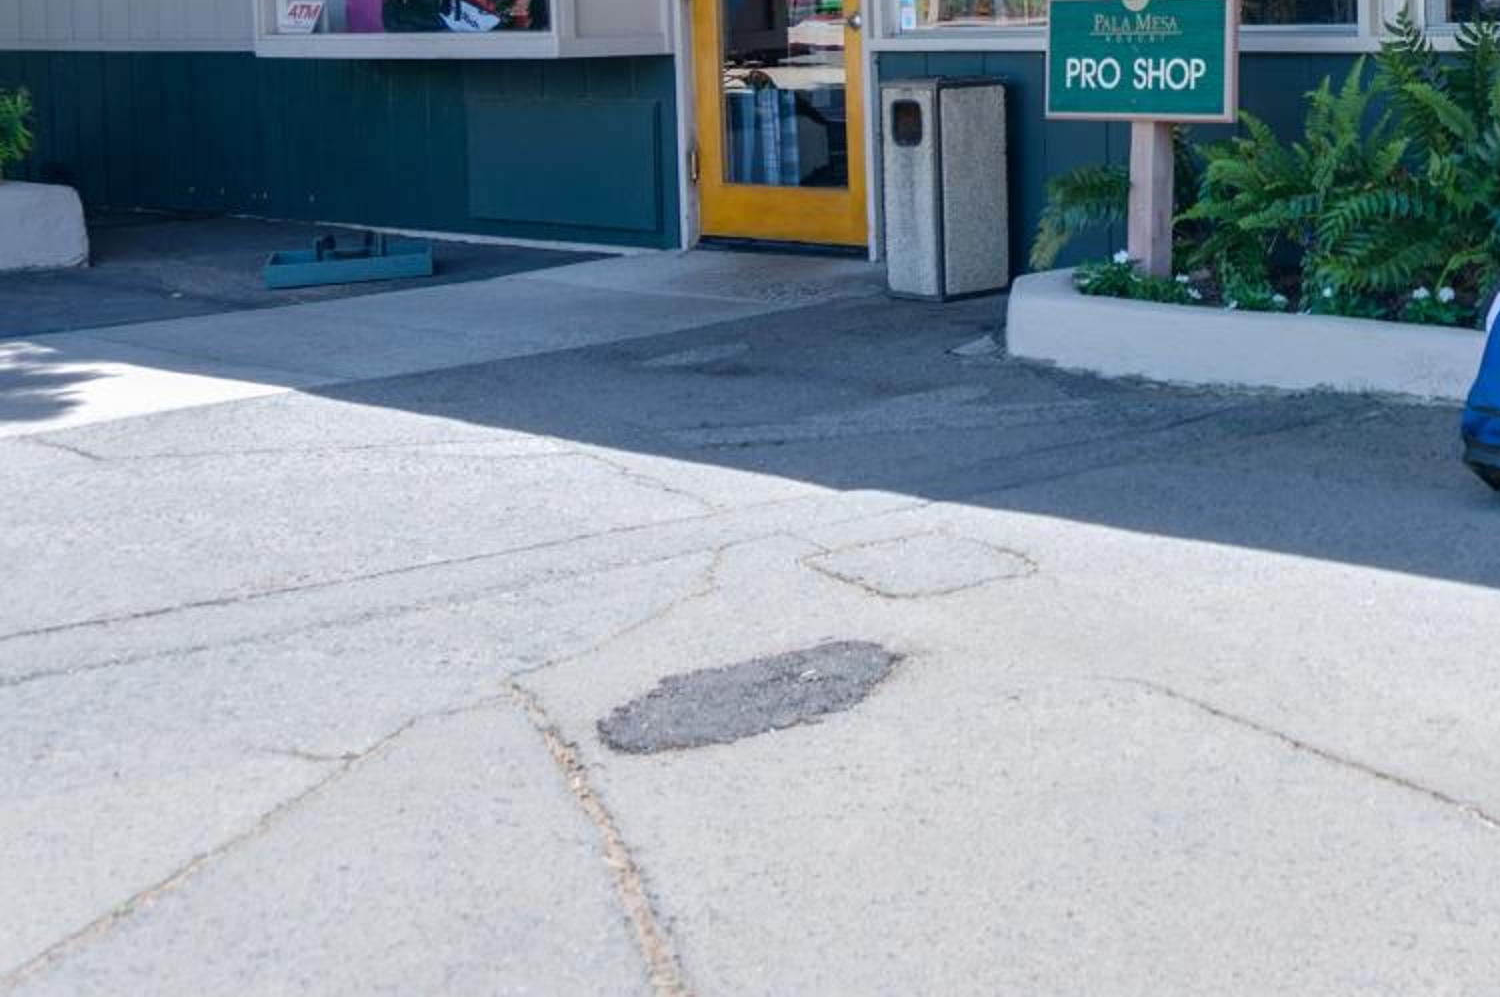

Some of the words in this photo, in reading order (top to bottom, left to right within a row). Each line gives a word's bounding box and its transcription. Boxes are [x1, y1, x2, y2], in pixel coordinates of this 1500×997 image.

[288, 4, 320, 20] ATM
[1065, 57, 1121, 89] PRO
[1133, 57, 1206, 90] SHOP
